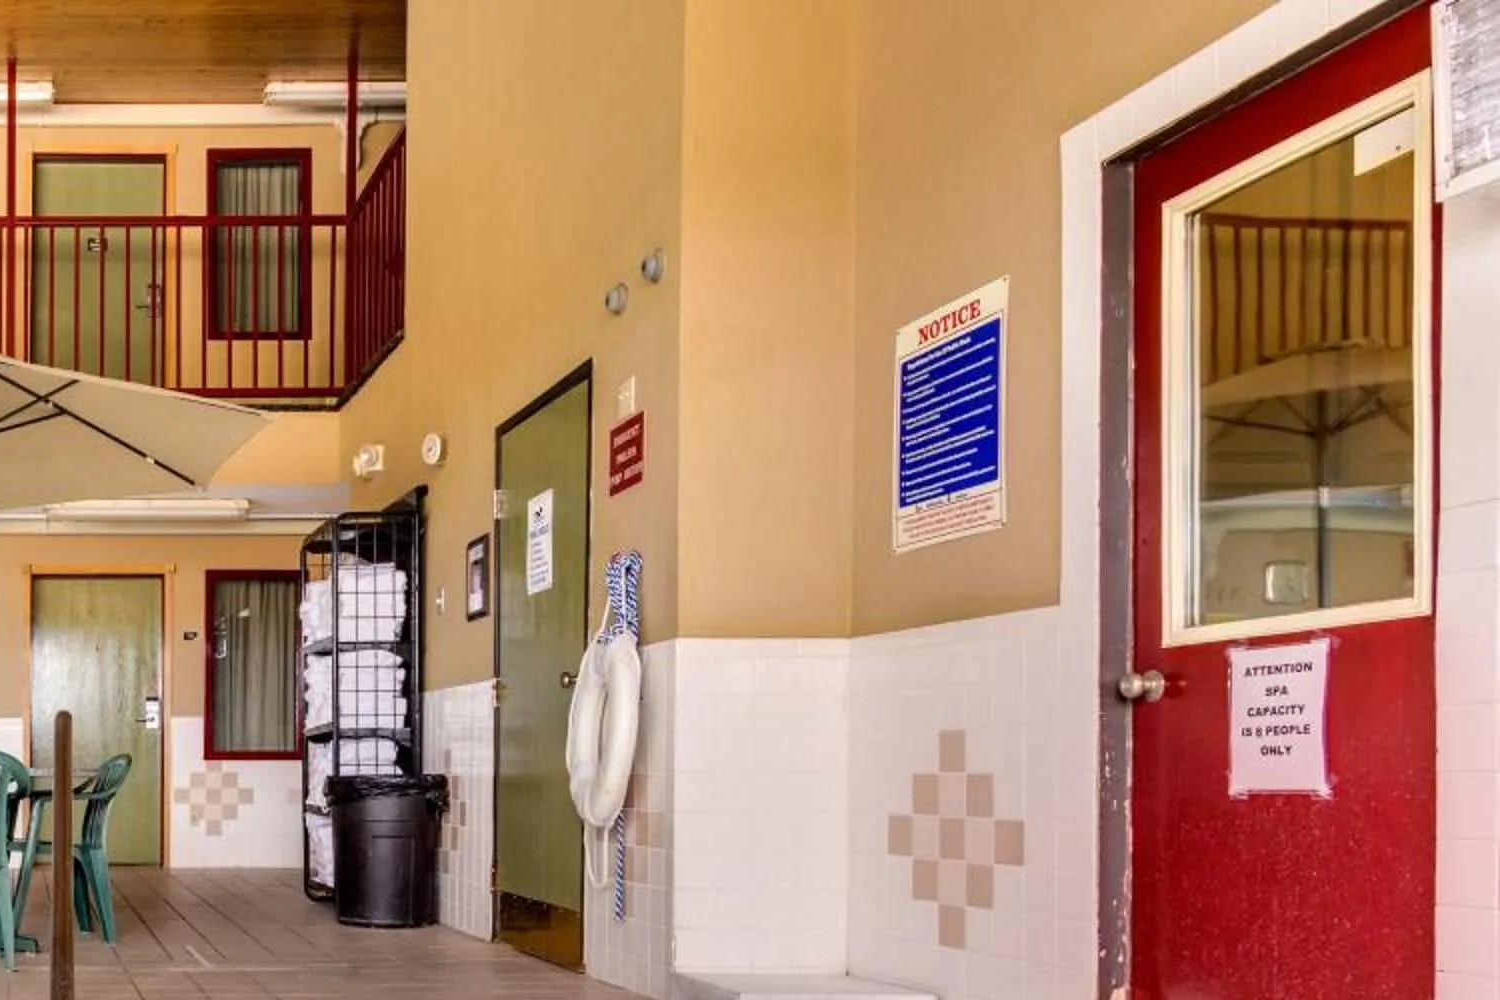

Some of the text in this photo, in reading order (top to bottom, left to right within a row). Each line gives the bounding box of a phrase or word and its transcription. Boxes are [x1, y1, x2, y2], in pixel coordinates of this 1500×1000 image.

[917, 298, 981, 346] NOTICE
[1243, 662, 1313, 677] ATTENTION
[1264, 685, 1289, 697] SPA
[1246, 704, 1305, 717] CAPACITY
[1241, 724, 1311, 738] IS 8 PEOPLE
[1260, 745, 1292, 757] ONLY
